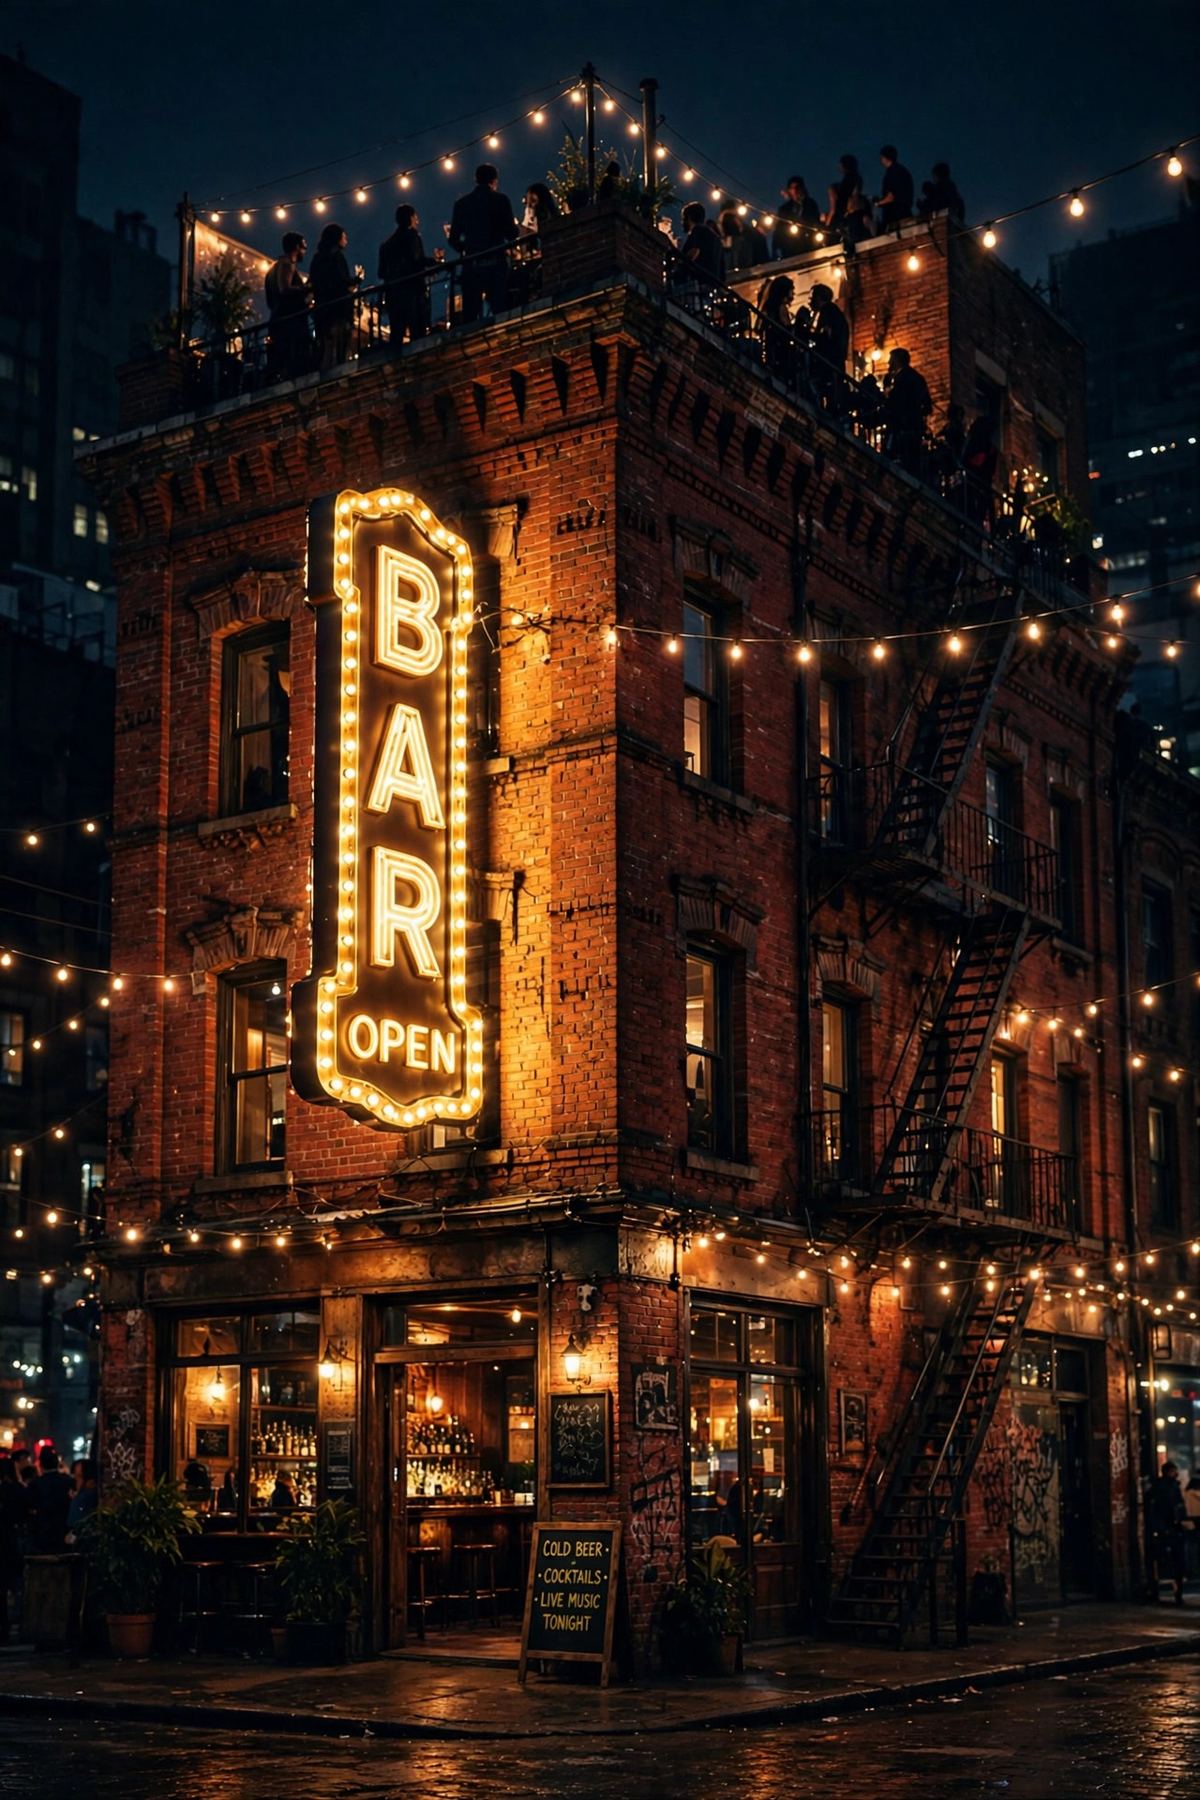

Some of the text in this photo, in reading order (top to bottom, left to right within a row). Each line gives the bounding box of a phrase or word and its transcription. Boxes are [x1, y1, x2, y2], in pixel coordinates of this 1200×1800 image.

[367, 544, 446, 979] BAR
[348, 1014, 456, 1074] OPEN
[543, 1540, 603, 1557] COLD BEER
[543, 1568, 602, 1585] COCKTAILS
[540, 1592, 601, 1609] LIVE MUSIC
[543, 1613, 592, 1631] TONIGHT
